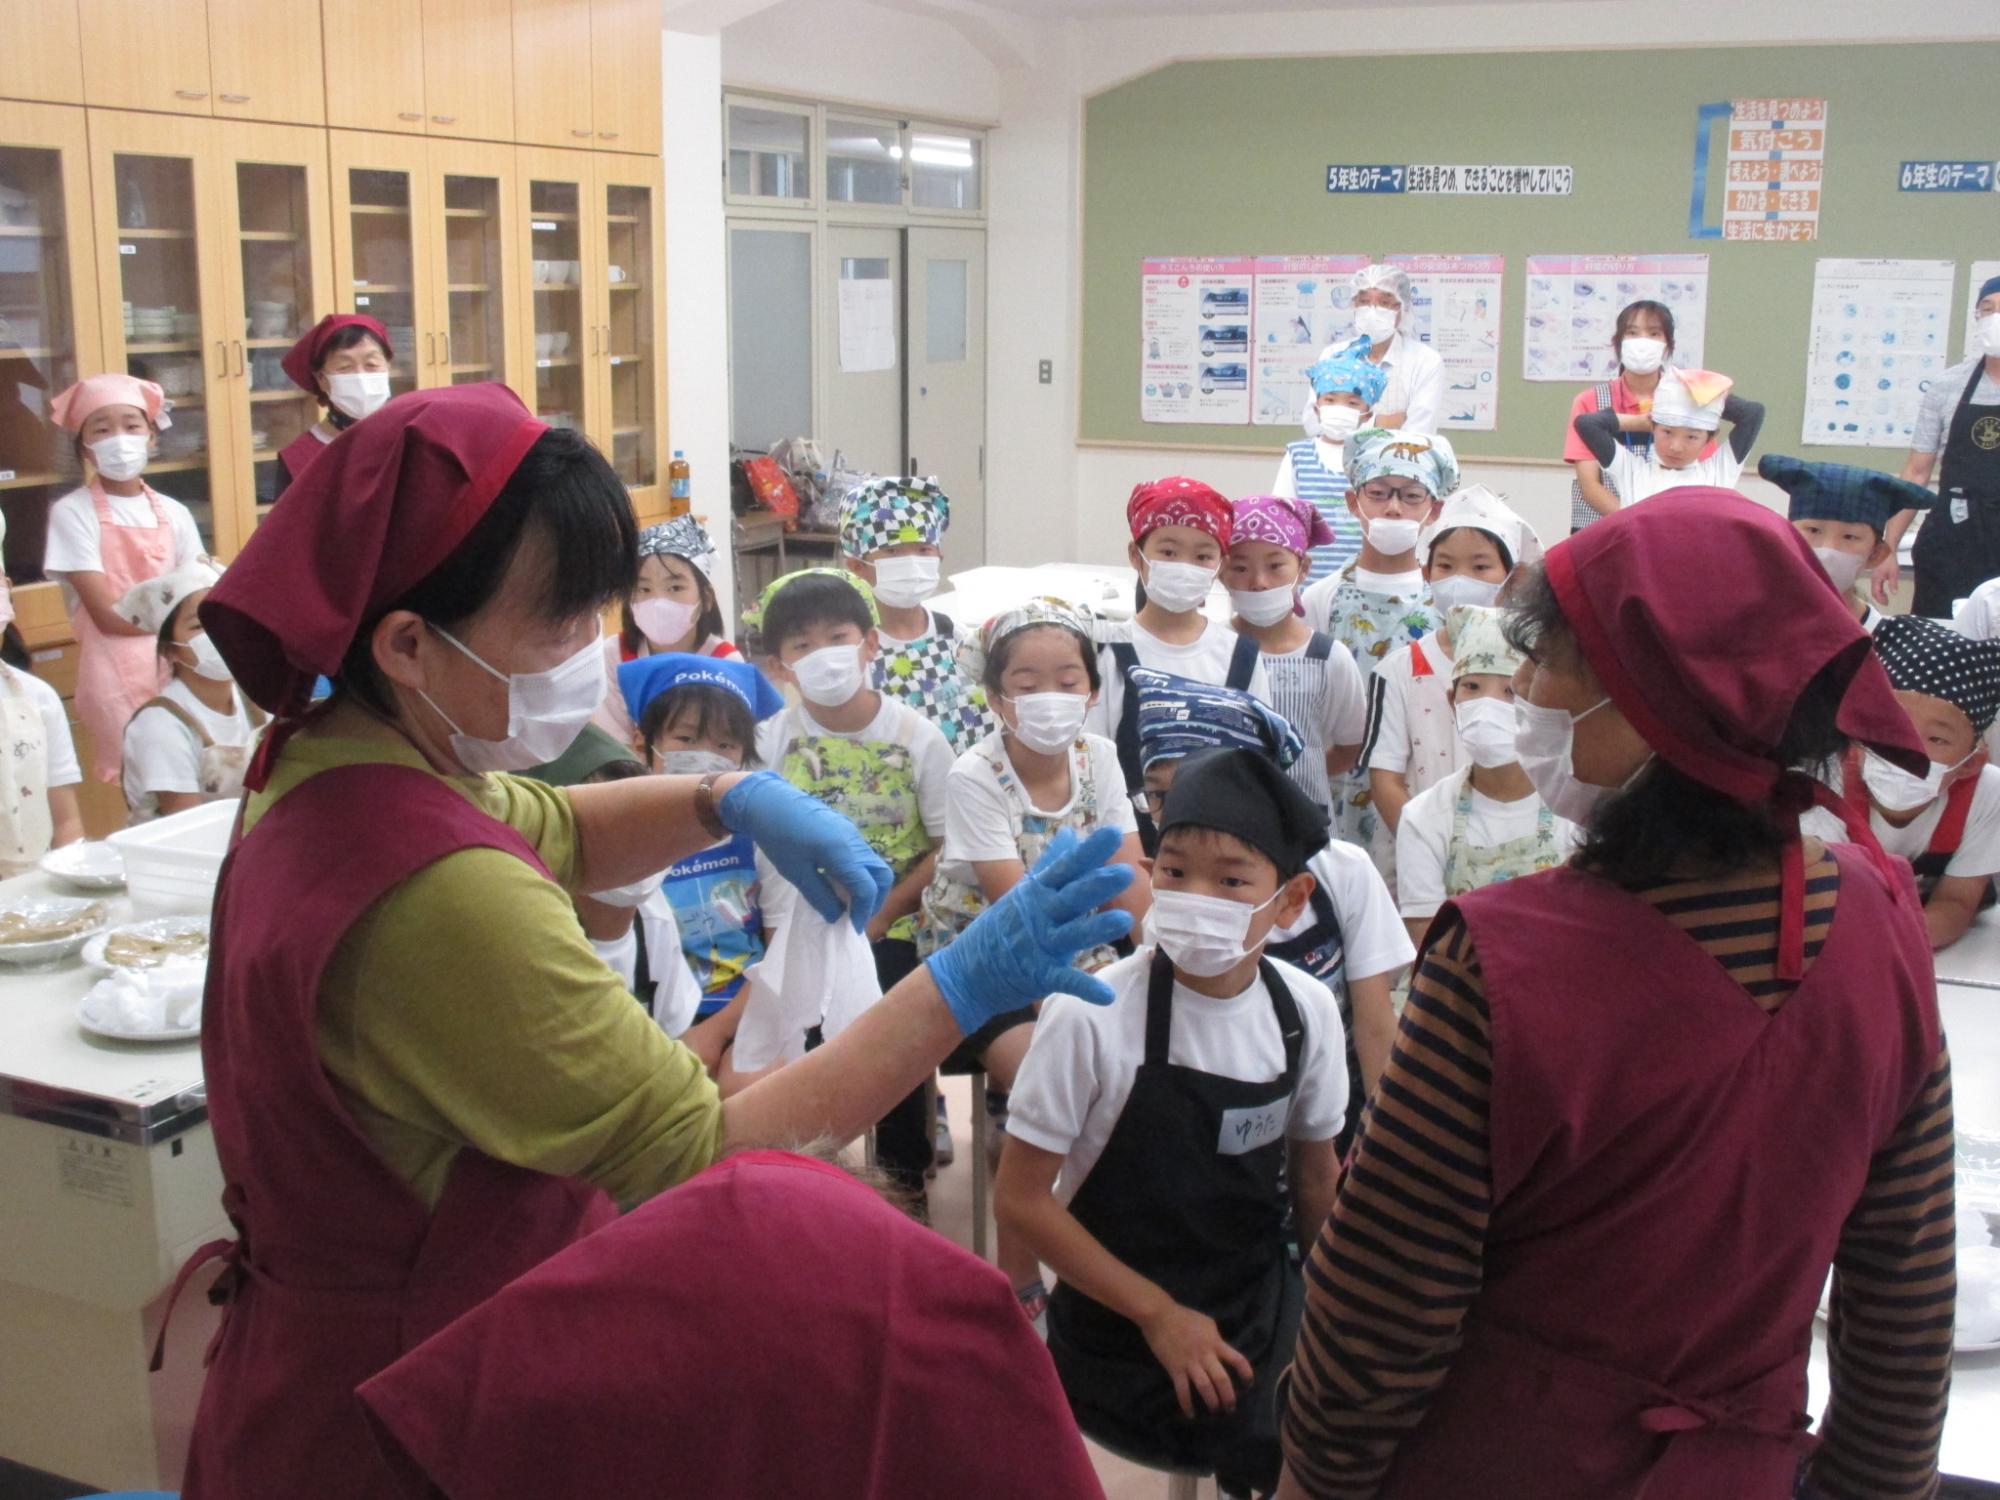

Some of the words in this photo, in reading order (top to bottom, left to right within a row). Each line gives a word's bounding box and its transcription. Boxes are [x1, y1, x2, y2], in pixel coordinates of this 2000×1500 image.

[1734, 101, 1823, 121] 生活を見つめよう
[1739, 131, 1813, 150] 気付こう
[1328, 167, 1403, 190] 5年生のテーマ
[1901, 164, 1989, 189] 6年生のテーマ
[1727, 221, 1814, 241] 生活に生かそう
[671, 855, 740, 877] okémon
